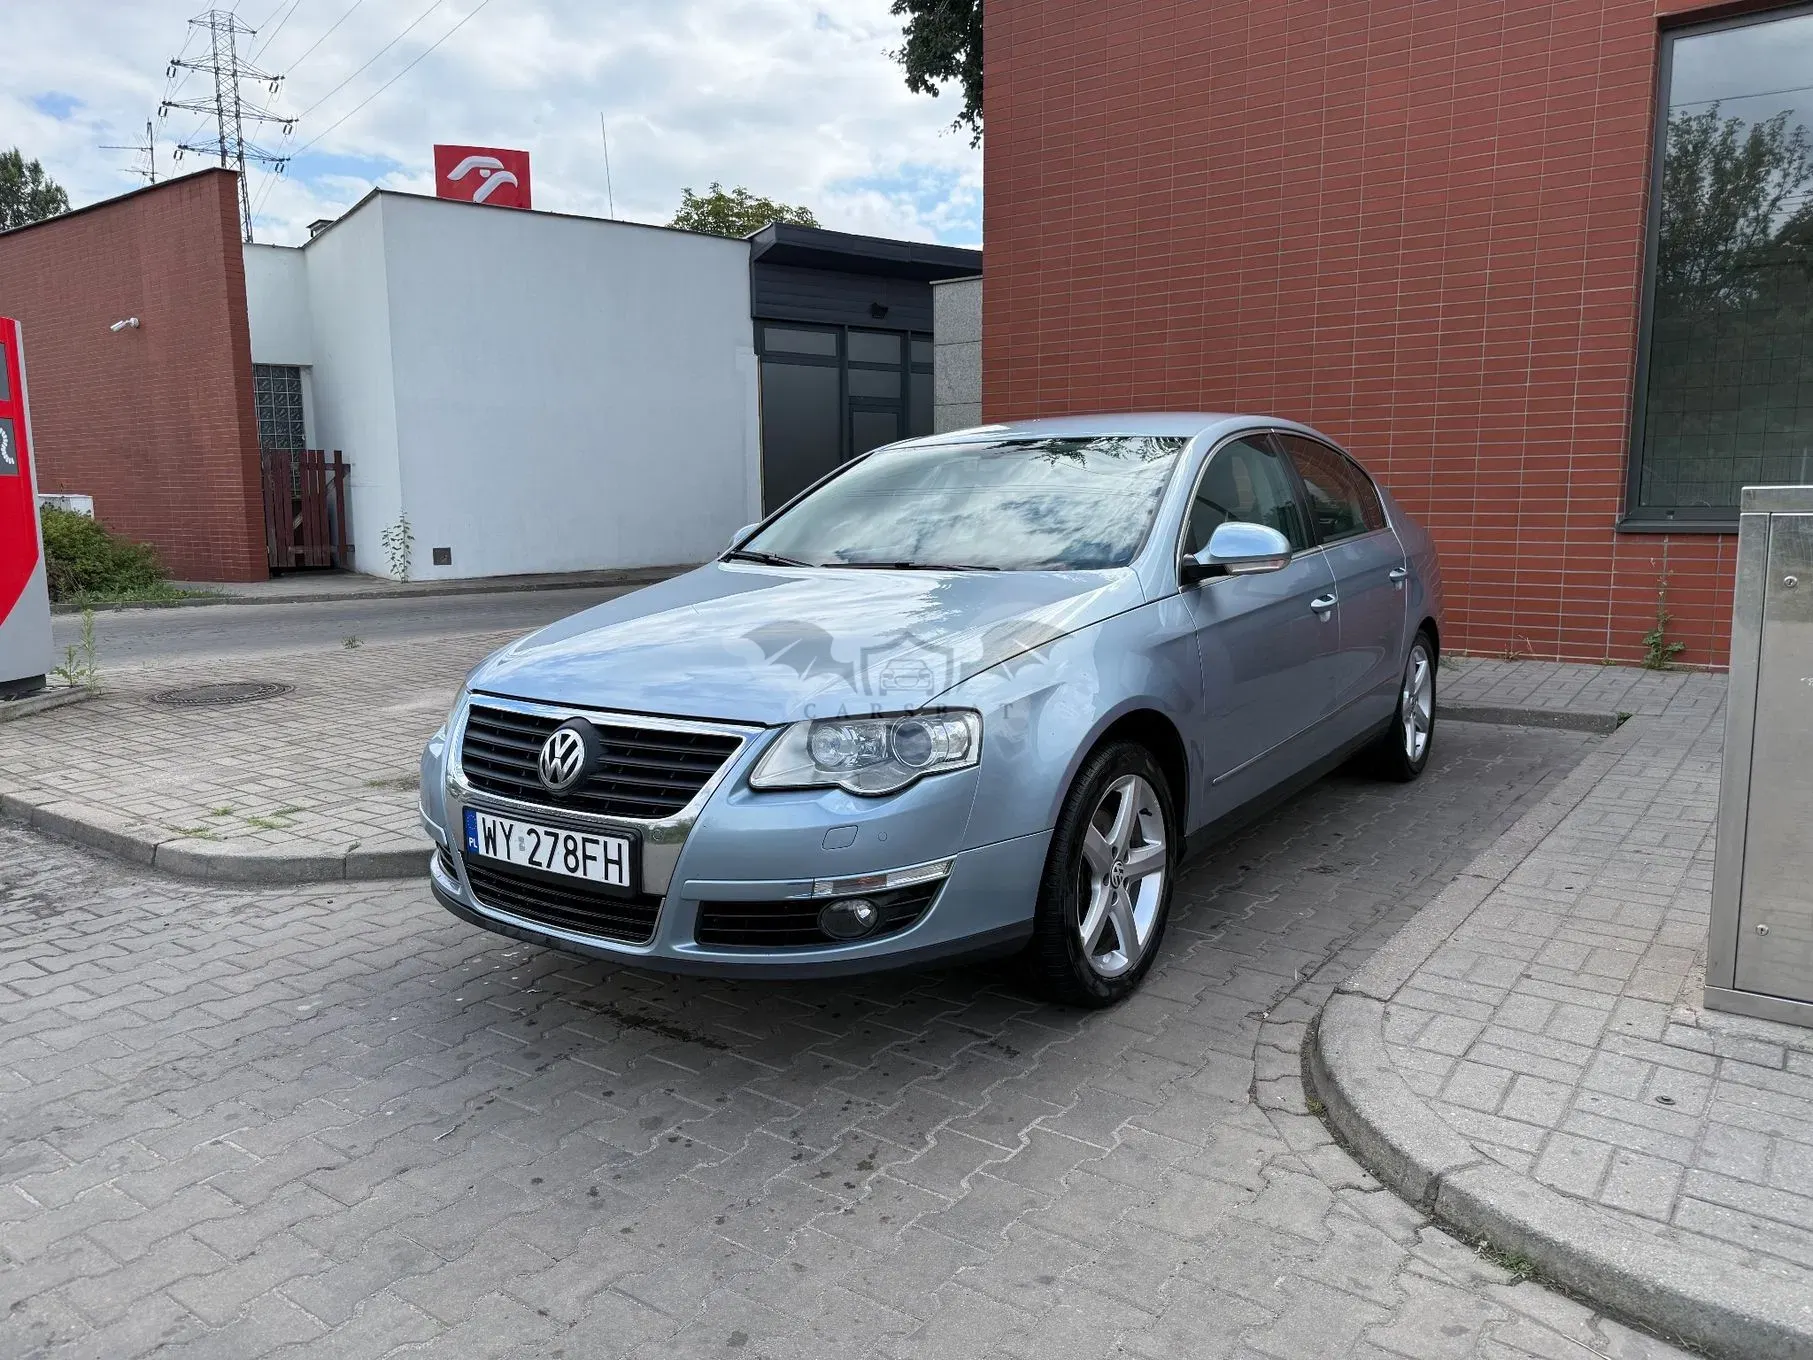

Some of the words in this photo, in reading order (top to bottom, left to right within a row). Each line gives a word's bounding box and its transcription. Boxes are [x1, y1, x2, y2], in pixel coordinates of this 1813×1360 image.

[468, 837, 478, 848] PL
[482, 817, 514, 861] WY
[527, 828, 623, 884] 278FH
